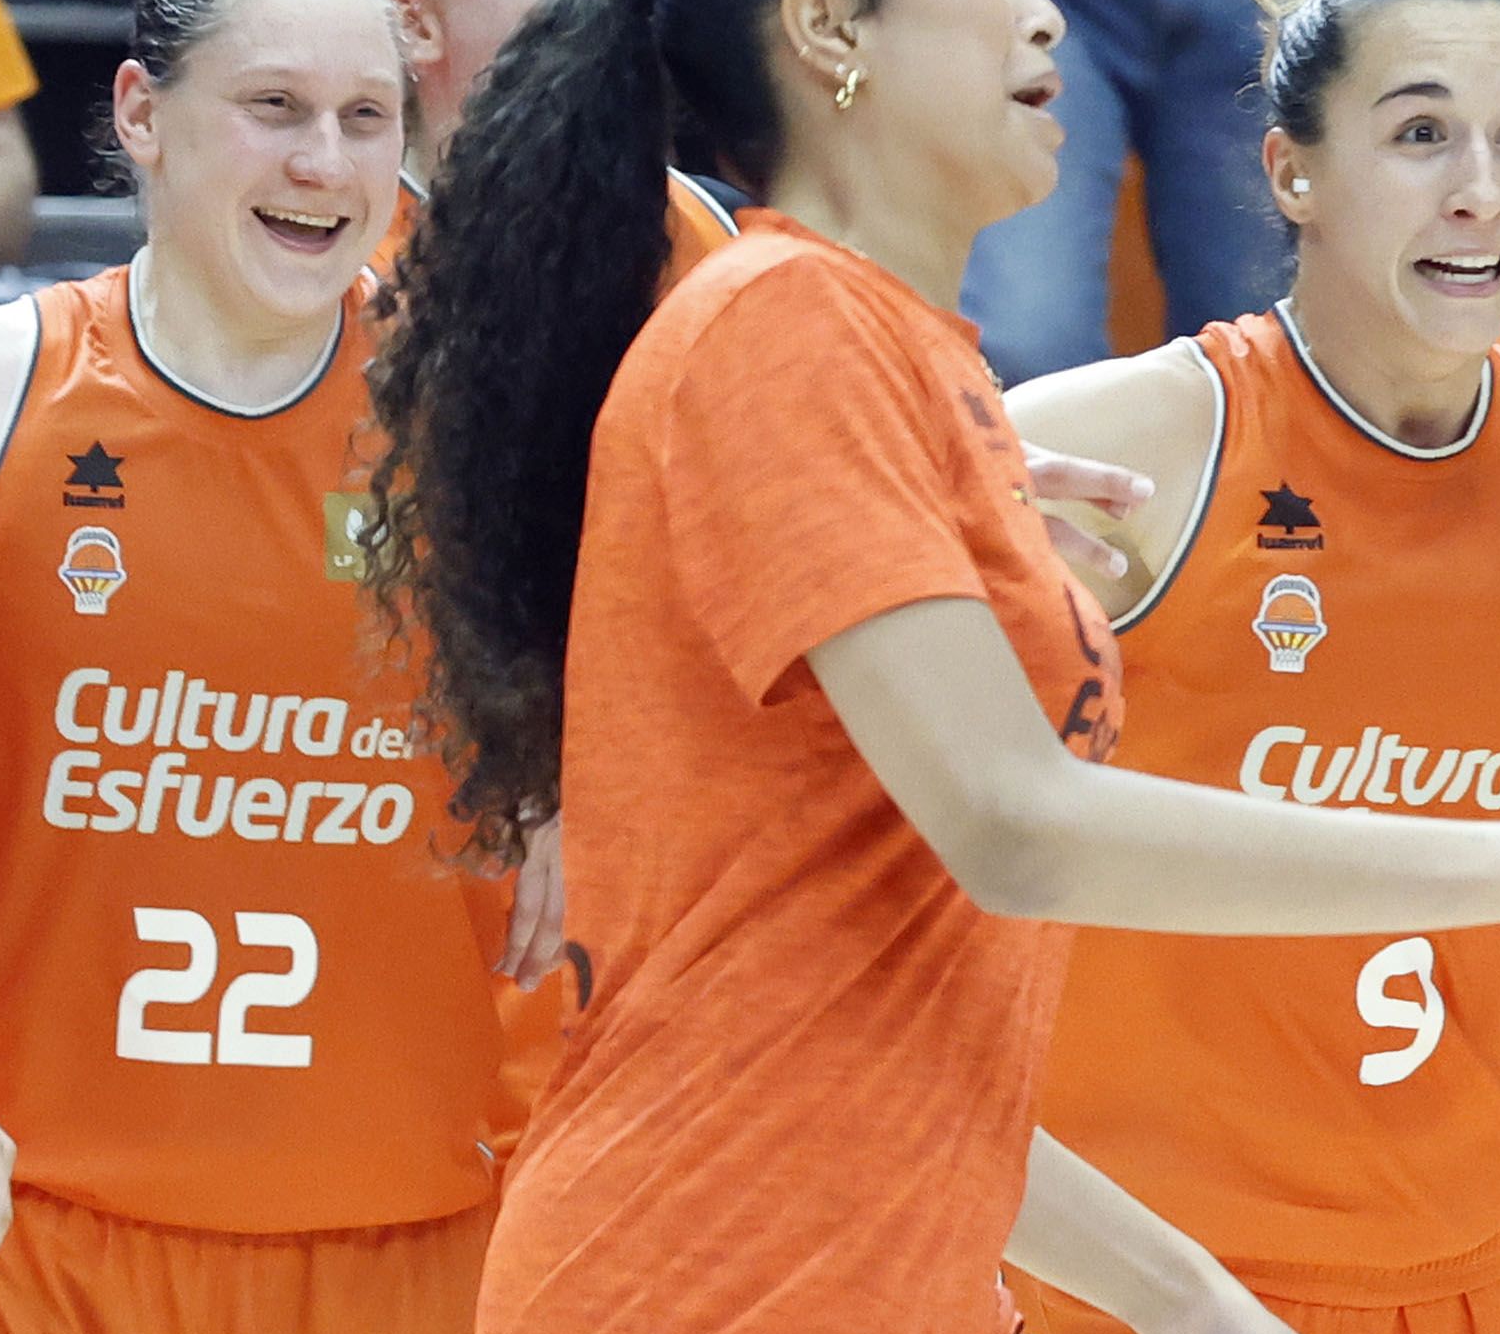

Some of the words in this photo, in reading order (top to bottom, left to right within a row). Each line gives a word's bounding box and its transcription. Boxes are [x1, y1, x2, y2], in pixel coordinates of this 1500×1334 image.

[54, 666, 350, 757] Cultura
[42, 748, 417, 846] Esfuerzo
[115, 907, 320, 1069] 22
[1355, 935, 1446, 1086] 9
